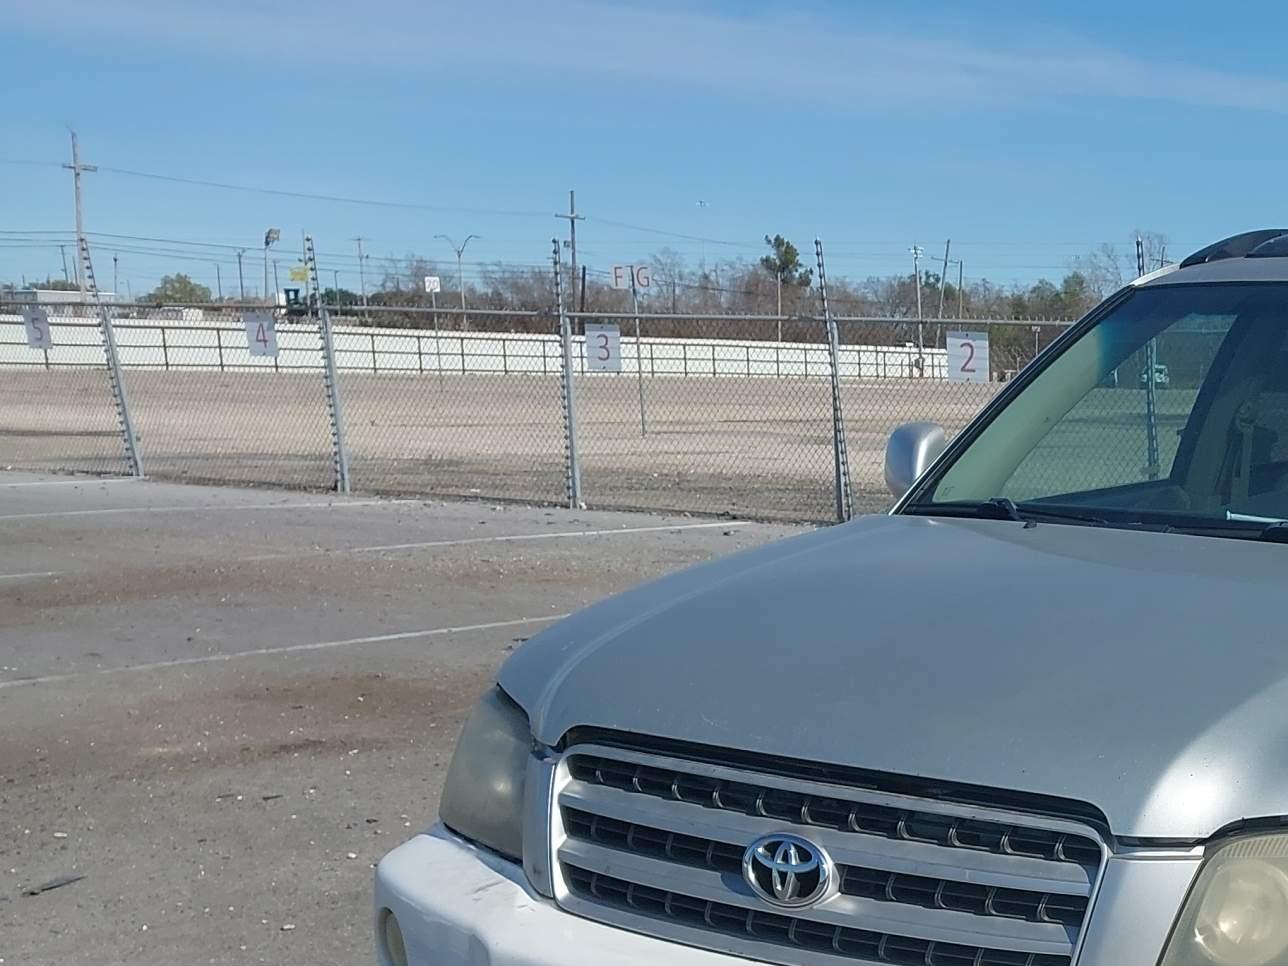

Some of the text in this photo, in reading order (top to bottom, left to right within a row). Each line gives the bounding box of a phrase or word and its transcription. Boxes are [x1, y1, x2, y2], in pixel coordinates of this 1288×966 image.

[613, 266, 623, 287] F
[636, 266, 650, 288] G
[31, 317, 44, 340] 5
[255, 322, 269, 348] 4
[596, 333, 611, 361] 3
[959, 342, 977, 373] 2
